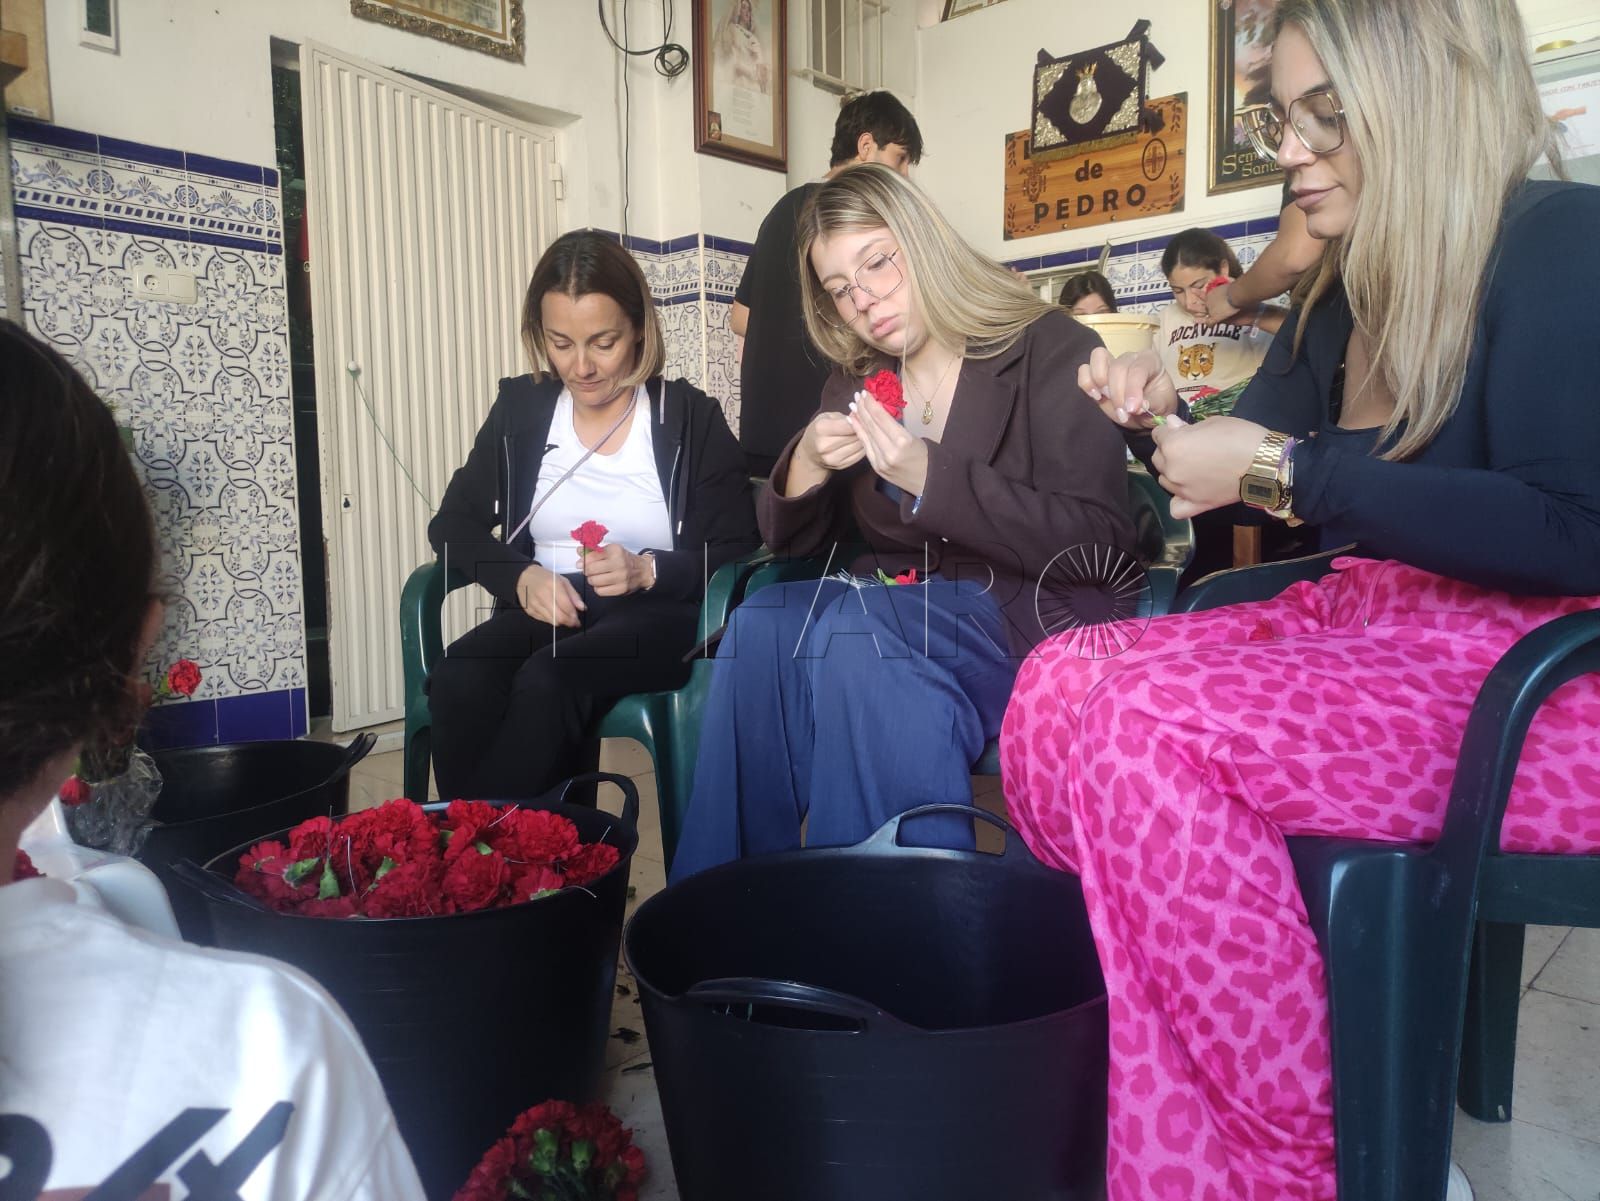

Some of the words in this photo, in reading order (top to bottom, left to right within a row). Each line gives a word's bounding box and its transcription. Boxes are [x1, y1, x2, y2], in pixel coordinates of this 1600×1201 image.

[1075, 160, 1104, 182] de
[1221, 152, 1258, 176] Sem
[1034, 184, 1146, 224] PEDRO
